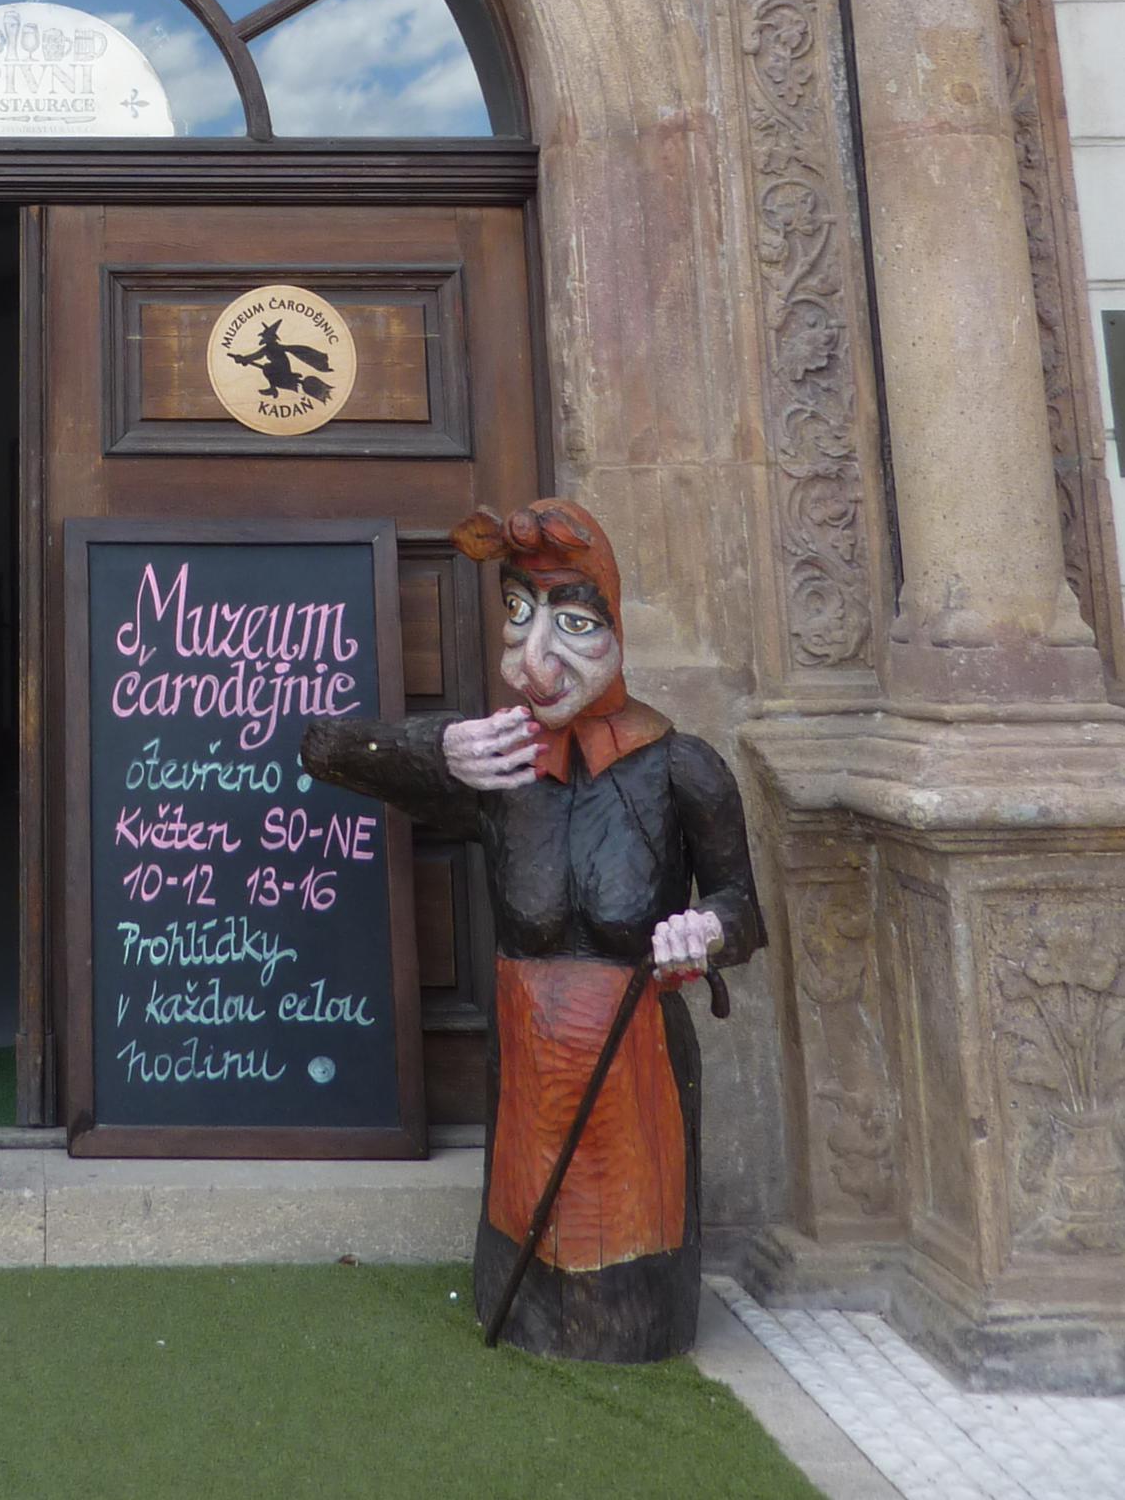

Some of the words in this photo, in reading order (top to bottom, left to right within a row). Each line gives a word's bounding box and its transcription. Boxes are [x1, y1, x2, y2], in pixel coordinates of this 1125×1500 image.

[221, 302, 265, 349] MUZEUM
[269, 297, 339, 345] ČARODĚJNIC
[258, 397, 314, 419] KADAŇ
[116, 562, 359, 662] Muzeum
[260, 807, 377, 860] SO-NE
[123, 863, 217, 906] 10-12
[246, 866, 338, 911] 13-16
[117, 916, 298, 987] Prohlídky
[145, 978, 266, 1026] každou
[278, 978, 376, 1026] celou
